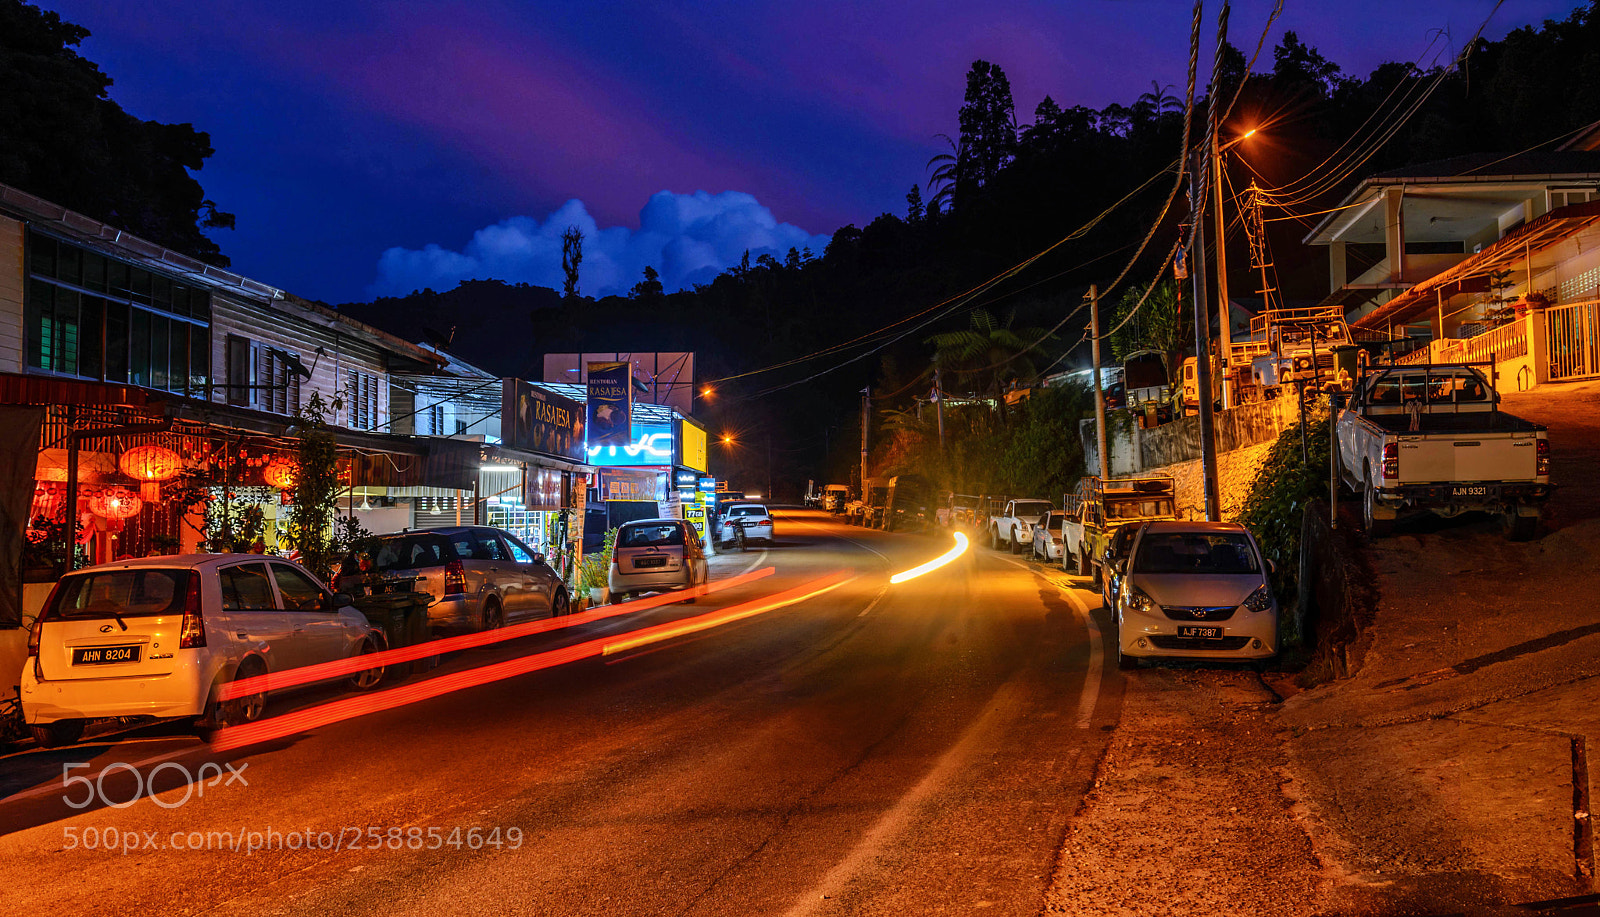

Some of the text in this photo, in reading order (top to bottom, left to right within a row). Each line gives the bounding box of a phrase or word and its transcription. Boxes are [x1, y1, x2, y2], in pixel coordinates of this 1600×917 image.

[1452, 487, 1487, 496] AJN 9321
[1183, 627, 1217, 637] AJF 7387
[82, 648, 131, 662] AHN 8204
